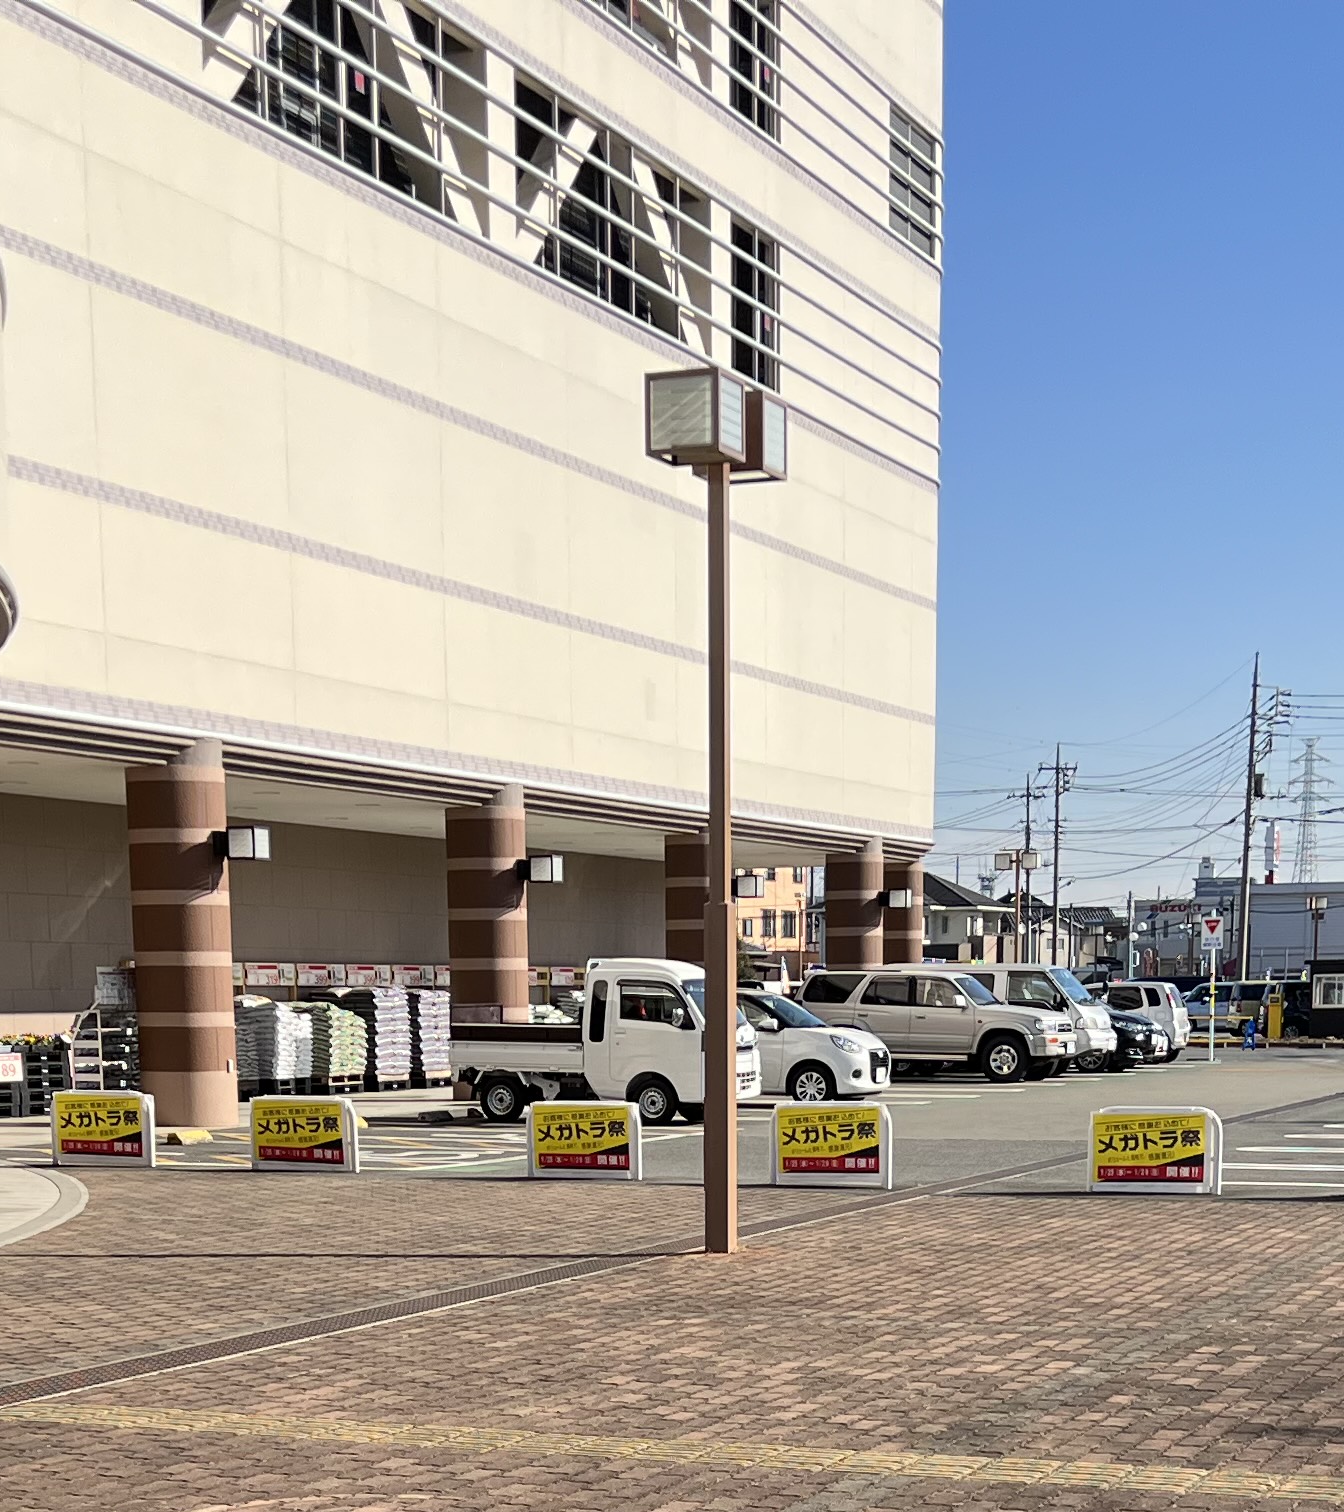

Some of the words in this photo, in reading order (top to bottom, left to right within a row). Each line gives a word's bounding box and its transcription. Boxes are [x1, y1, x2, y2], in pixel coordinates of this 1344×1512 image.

[1150, 903, 1202, 913] SUZUI
[60, 1110, 139, 1129] メガトラ祭
[257, 1116, 340, 1135] メガトラ祭
[537, 1120, 626, 1142] メガトラ祭
[782, 1122, 876, 1146] メガトラ祭
[1097, 1129, 1201, 1154] メガトラ祭
